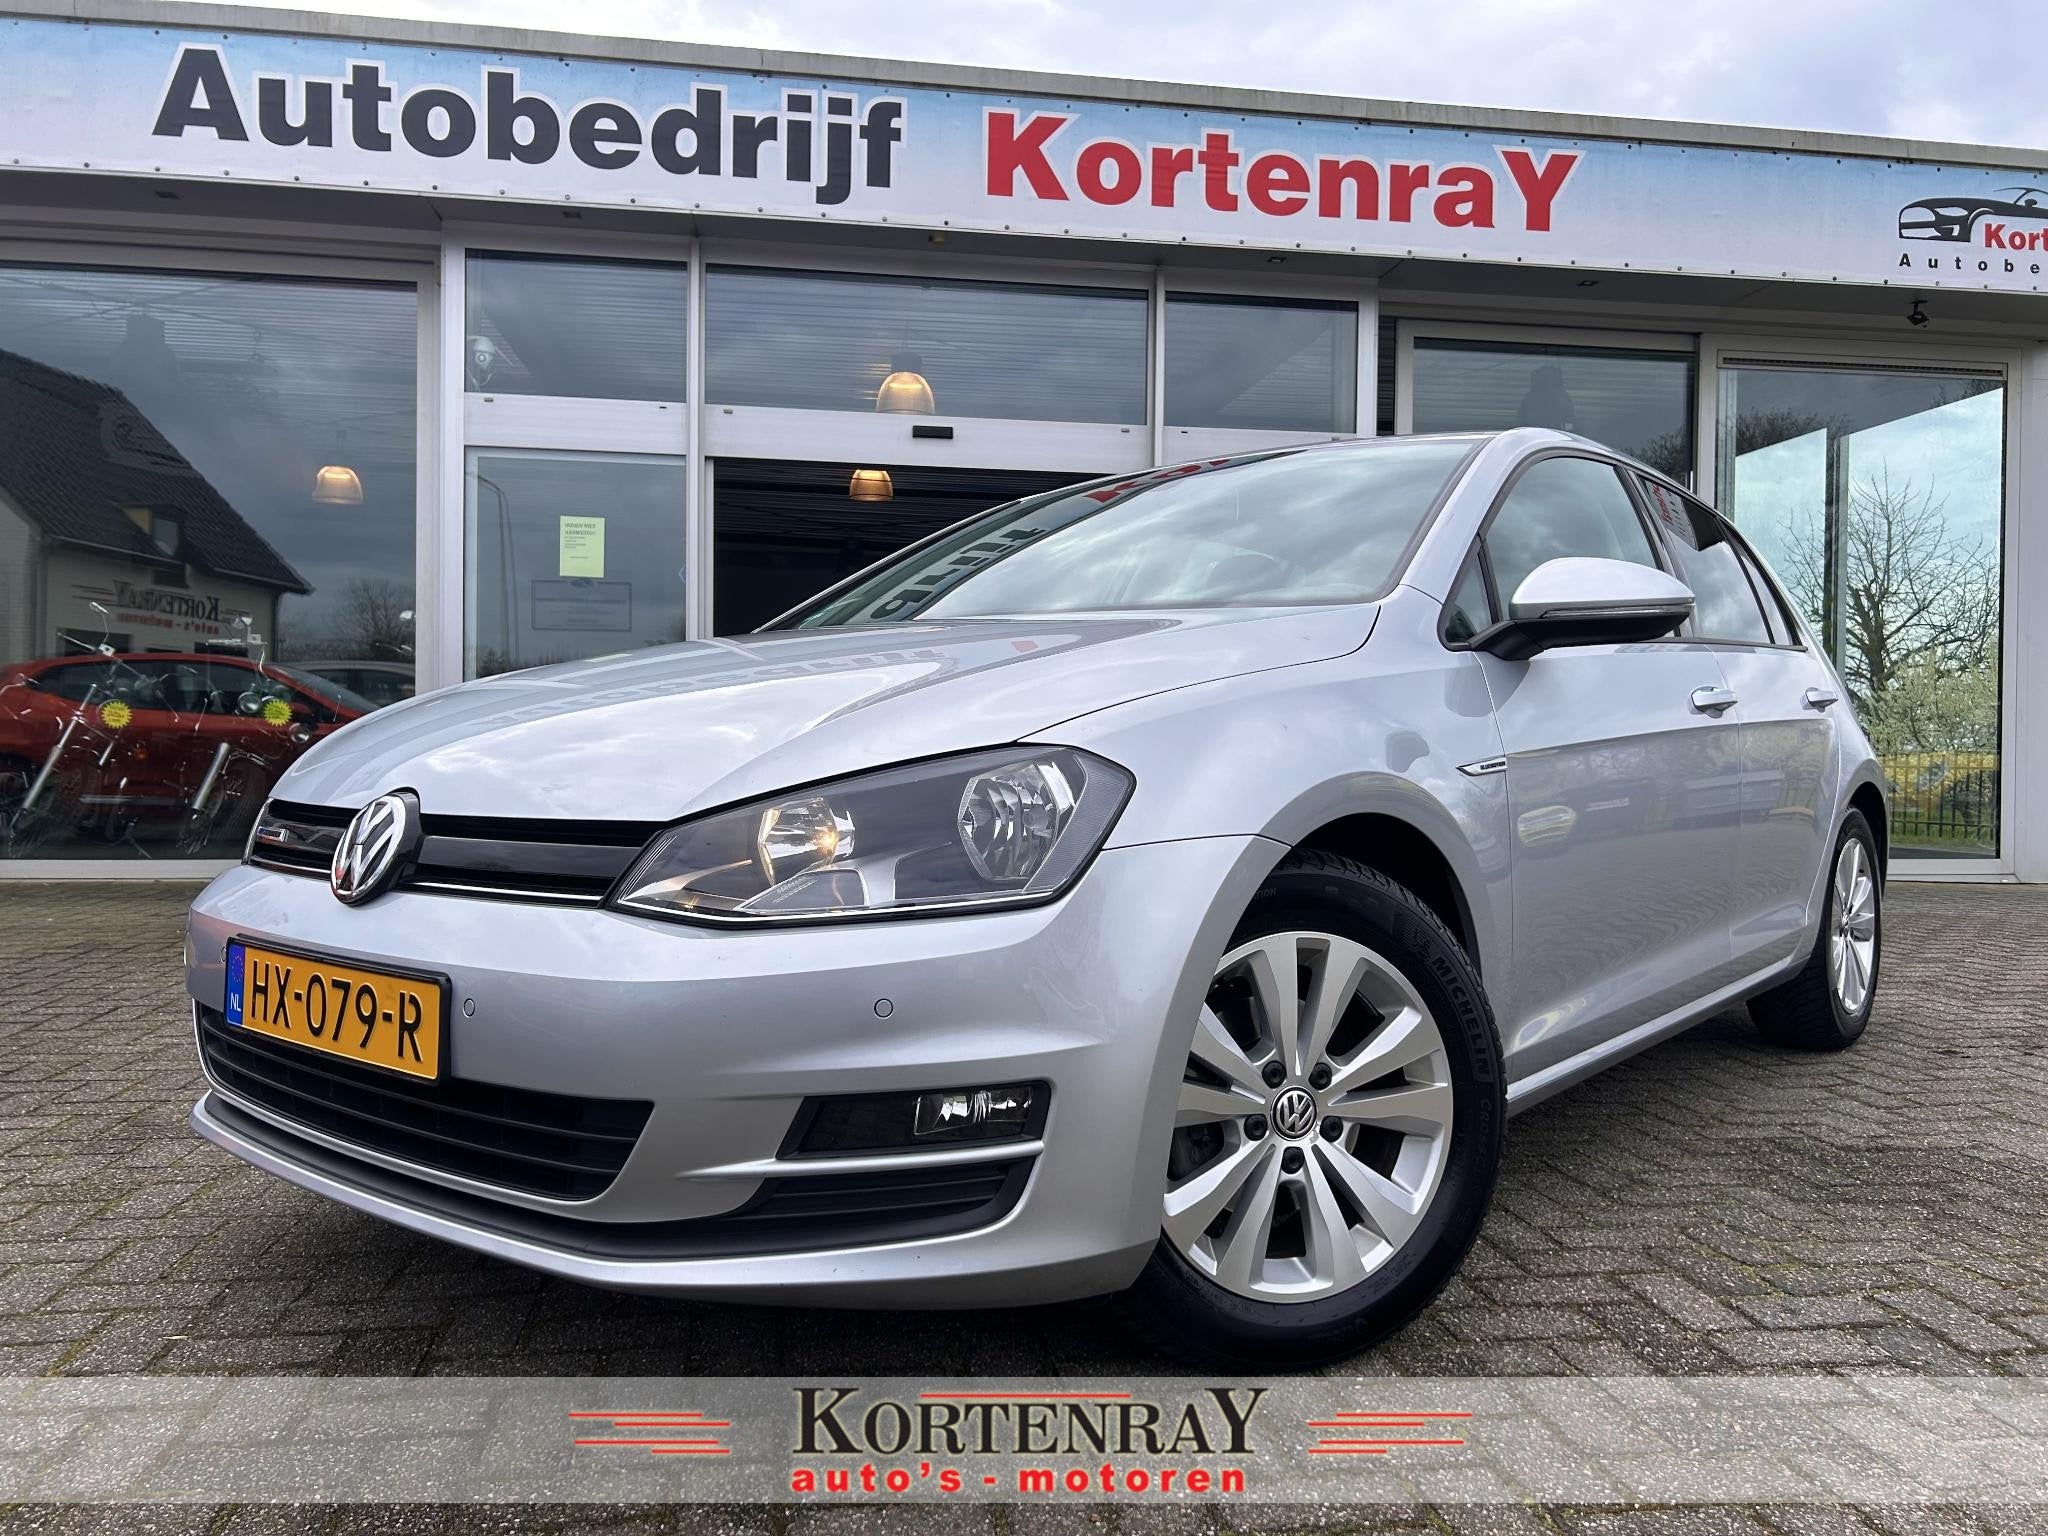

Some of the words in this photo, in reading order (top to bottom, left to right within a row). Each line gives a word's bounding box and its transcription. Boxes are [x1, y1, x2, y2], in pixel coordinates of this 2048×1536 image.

[152, 48, 901, 206] Autobedrijf
[986, 111, 1579, 232] KortenraY
[230, 992, 242, 1012] NL
[251, 959, 424, 1063] HX-079-R
[1431, 956, 1492, 1076] MICHELIN
